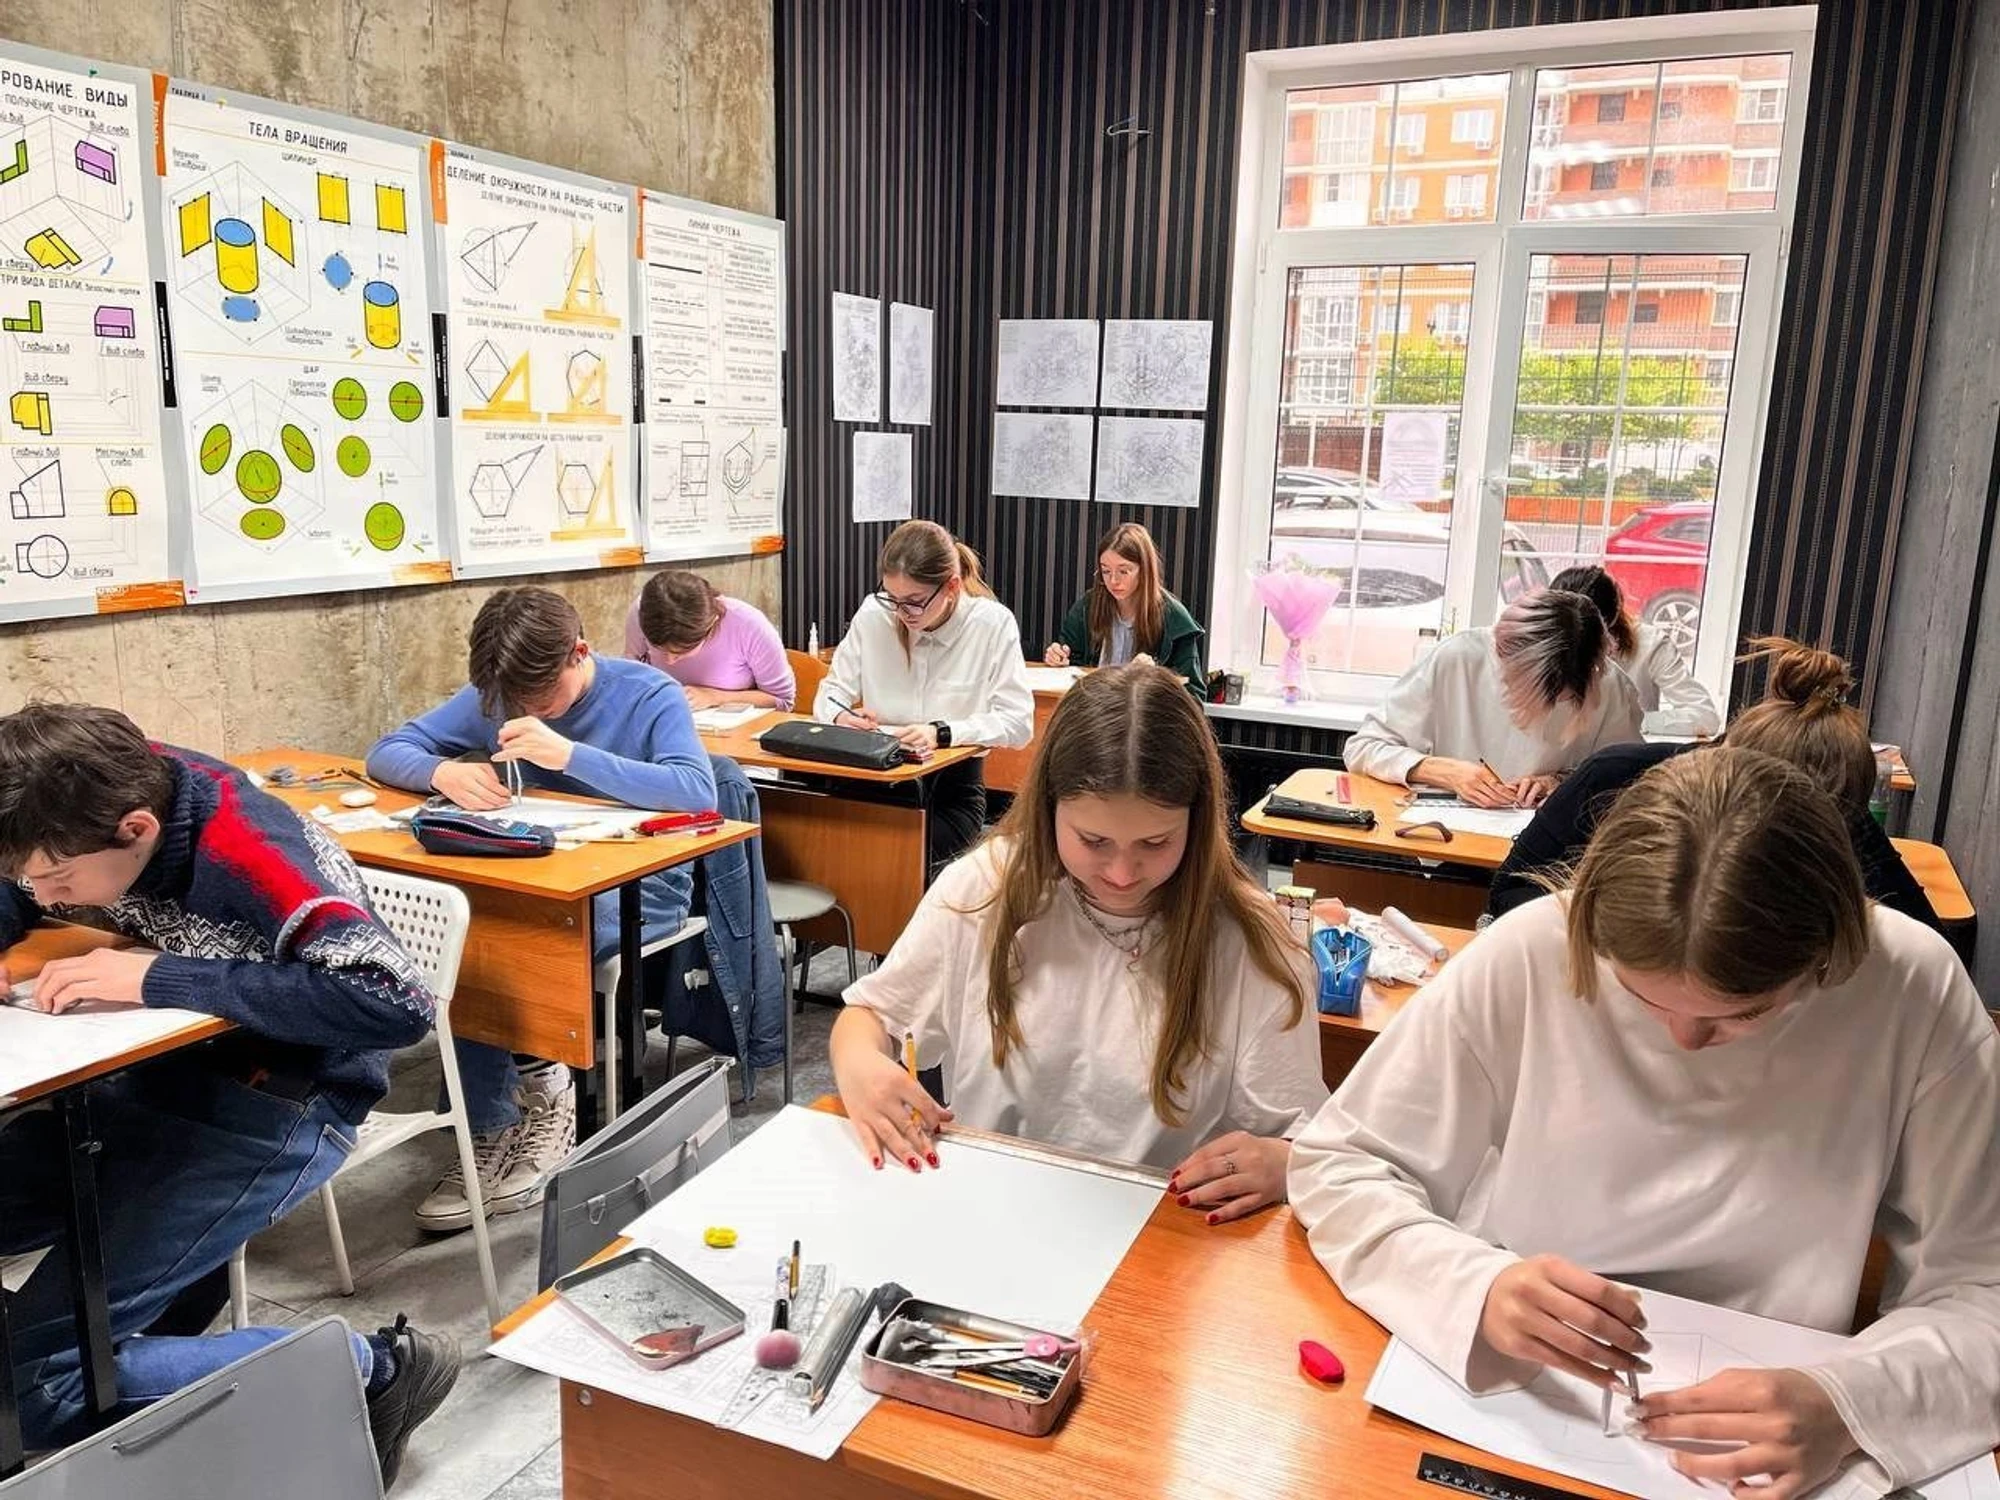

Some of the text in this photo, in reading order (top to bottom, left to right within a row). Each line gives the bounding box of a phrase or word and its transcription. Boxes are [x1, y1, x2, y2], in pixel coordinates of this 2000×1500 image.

[85, 87, 128, 108] ВИДЫ
[58, 104, 96, 119] ЧЕРТЕЖА
[249, 121, 348, 153] ТЕЛА ВРАЩЕНИЯ
[281, 151, 317, 165] ЦИЛИНДР
[447, 165, 486, 185] ДЕЛЕНИЕ
[490, 175, 548, 197] ОКРУЖНОСТИ
[550, 189, 561, 200] НА
[563, 191, 594, 209] РАВНЫЕ
[598, 200, 624, 214] ЧАСТИ
[1, 273, 18, 285] ТРИ
[20, 275, 45, 287] ВИДА
